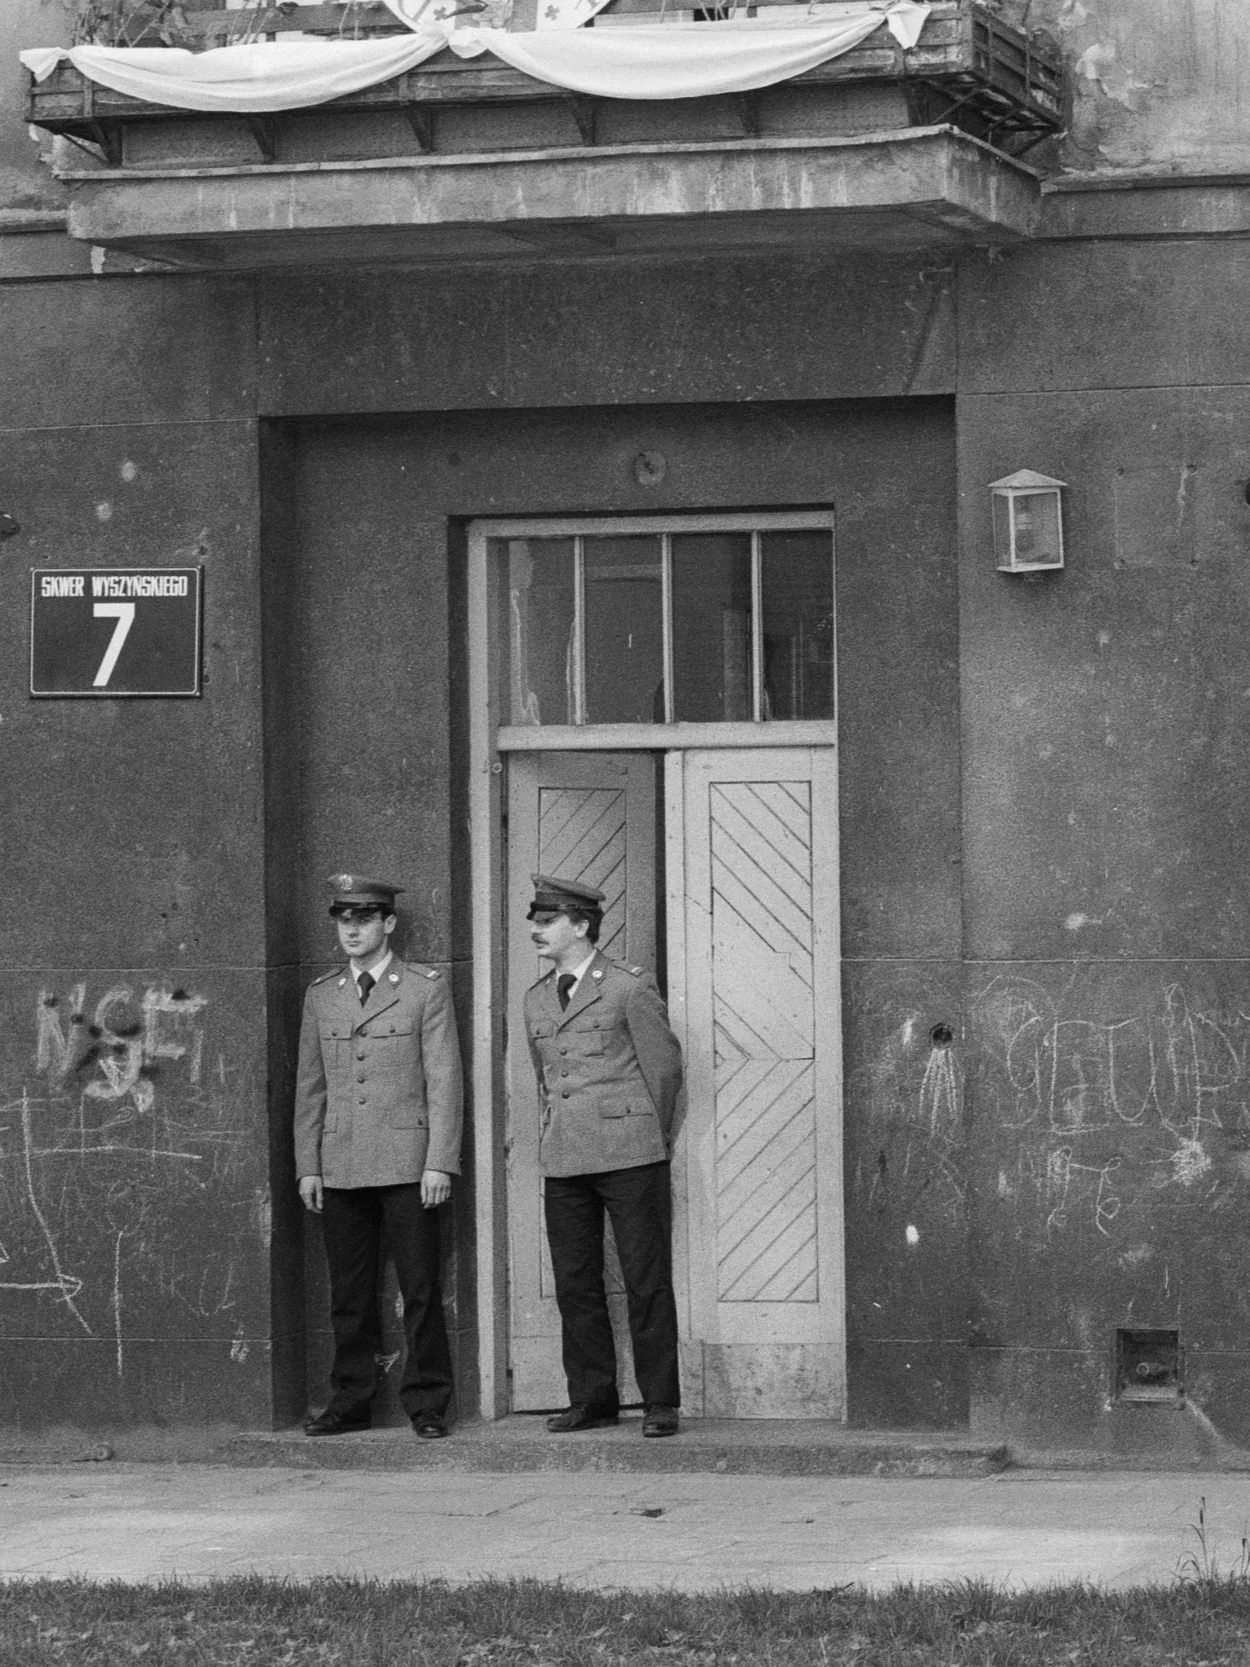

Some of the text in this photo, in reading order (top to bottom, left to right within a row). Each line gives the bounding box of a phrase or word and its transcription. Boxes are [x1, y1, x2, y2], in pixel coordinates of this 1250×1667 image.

[41, 575, 188, 597] SKWER WYSZYŃSKIEGO
[93, 603, 136, 686] 7
